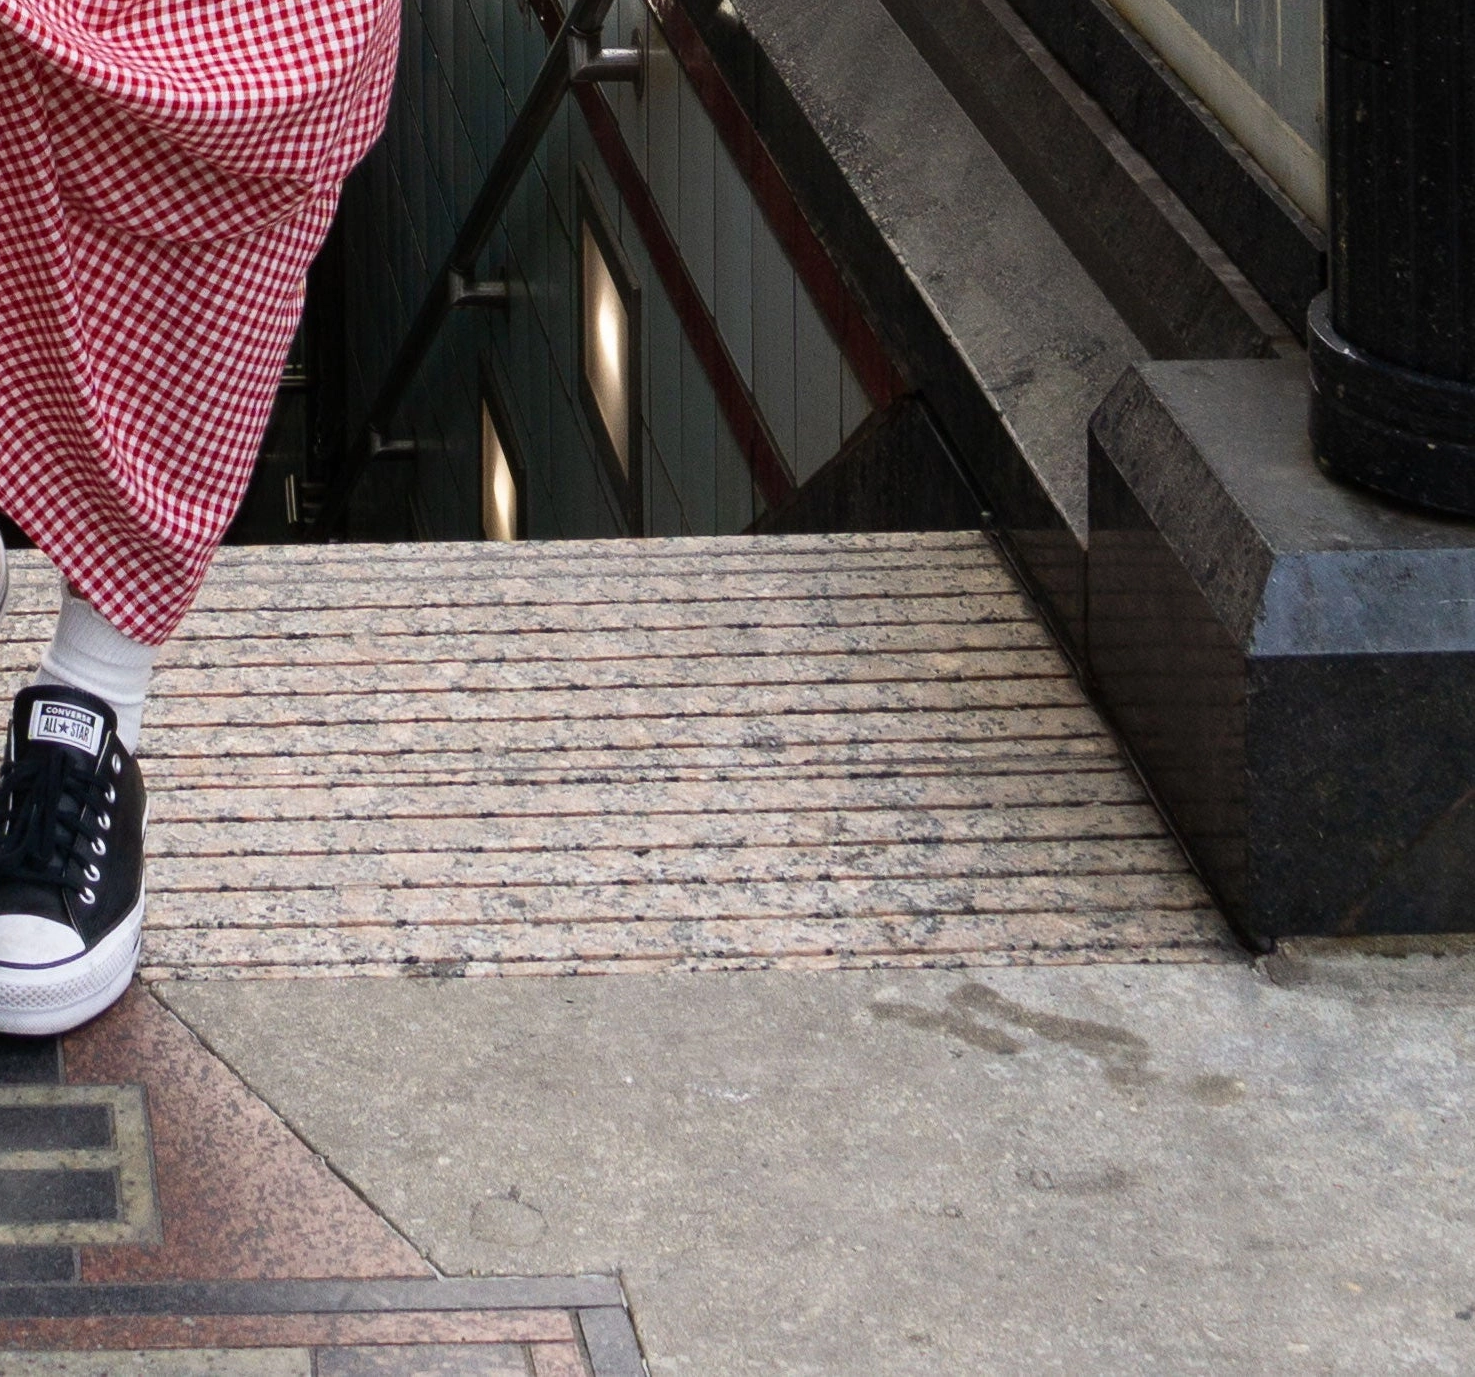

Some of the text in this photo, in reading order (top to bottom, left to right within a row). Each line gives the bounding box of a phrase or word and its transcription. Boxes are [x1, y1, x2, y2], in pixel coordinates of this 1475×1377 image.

[45, 706, 93, 724] CONVERSE
[43, 717, 91, 743] ALL STAR
